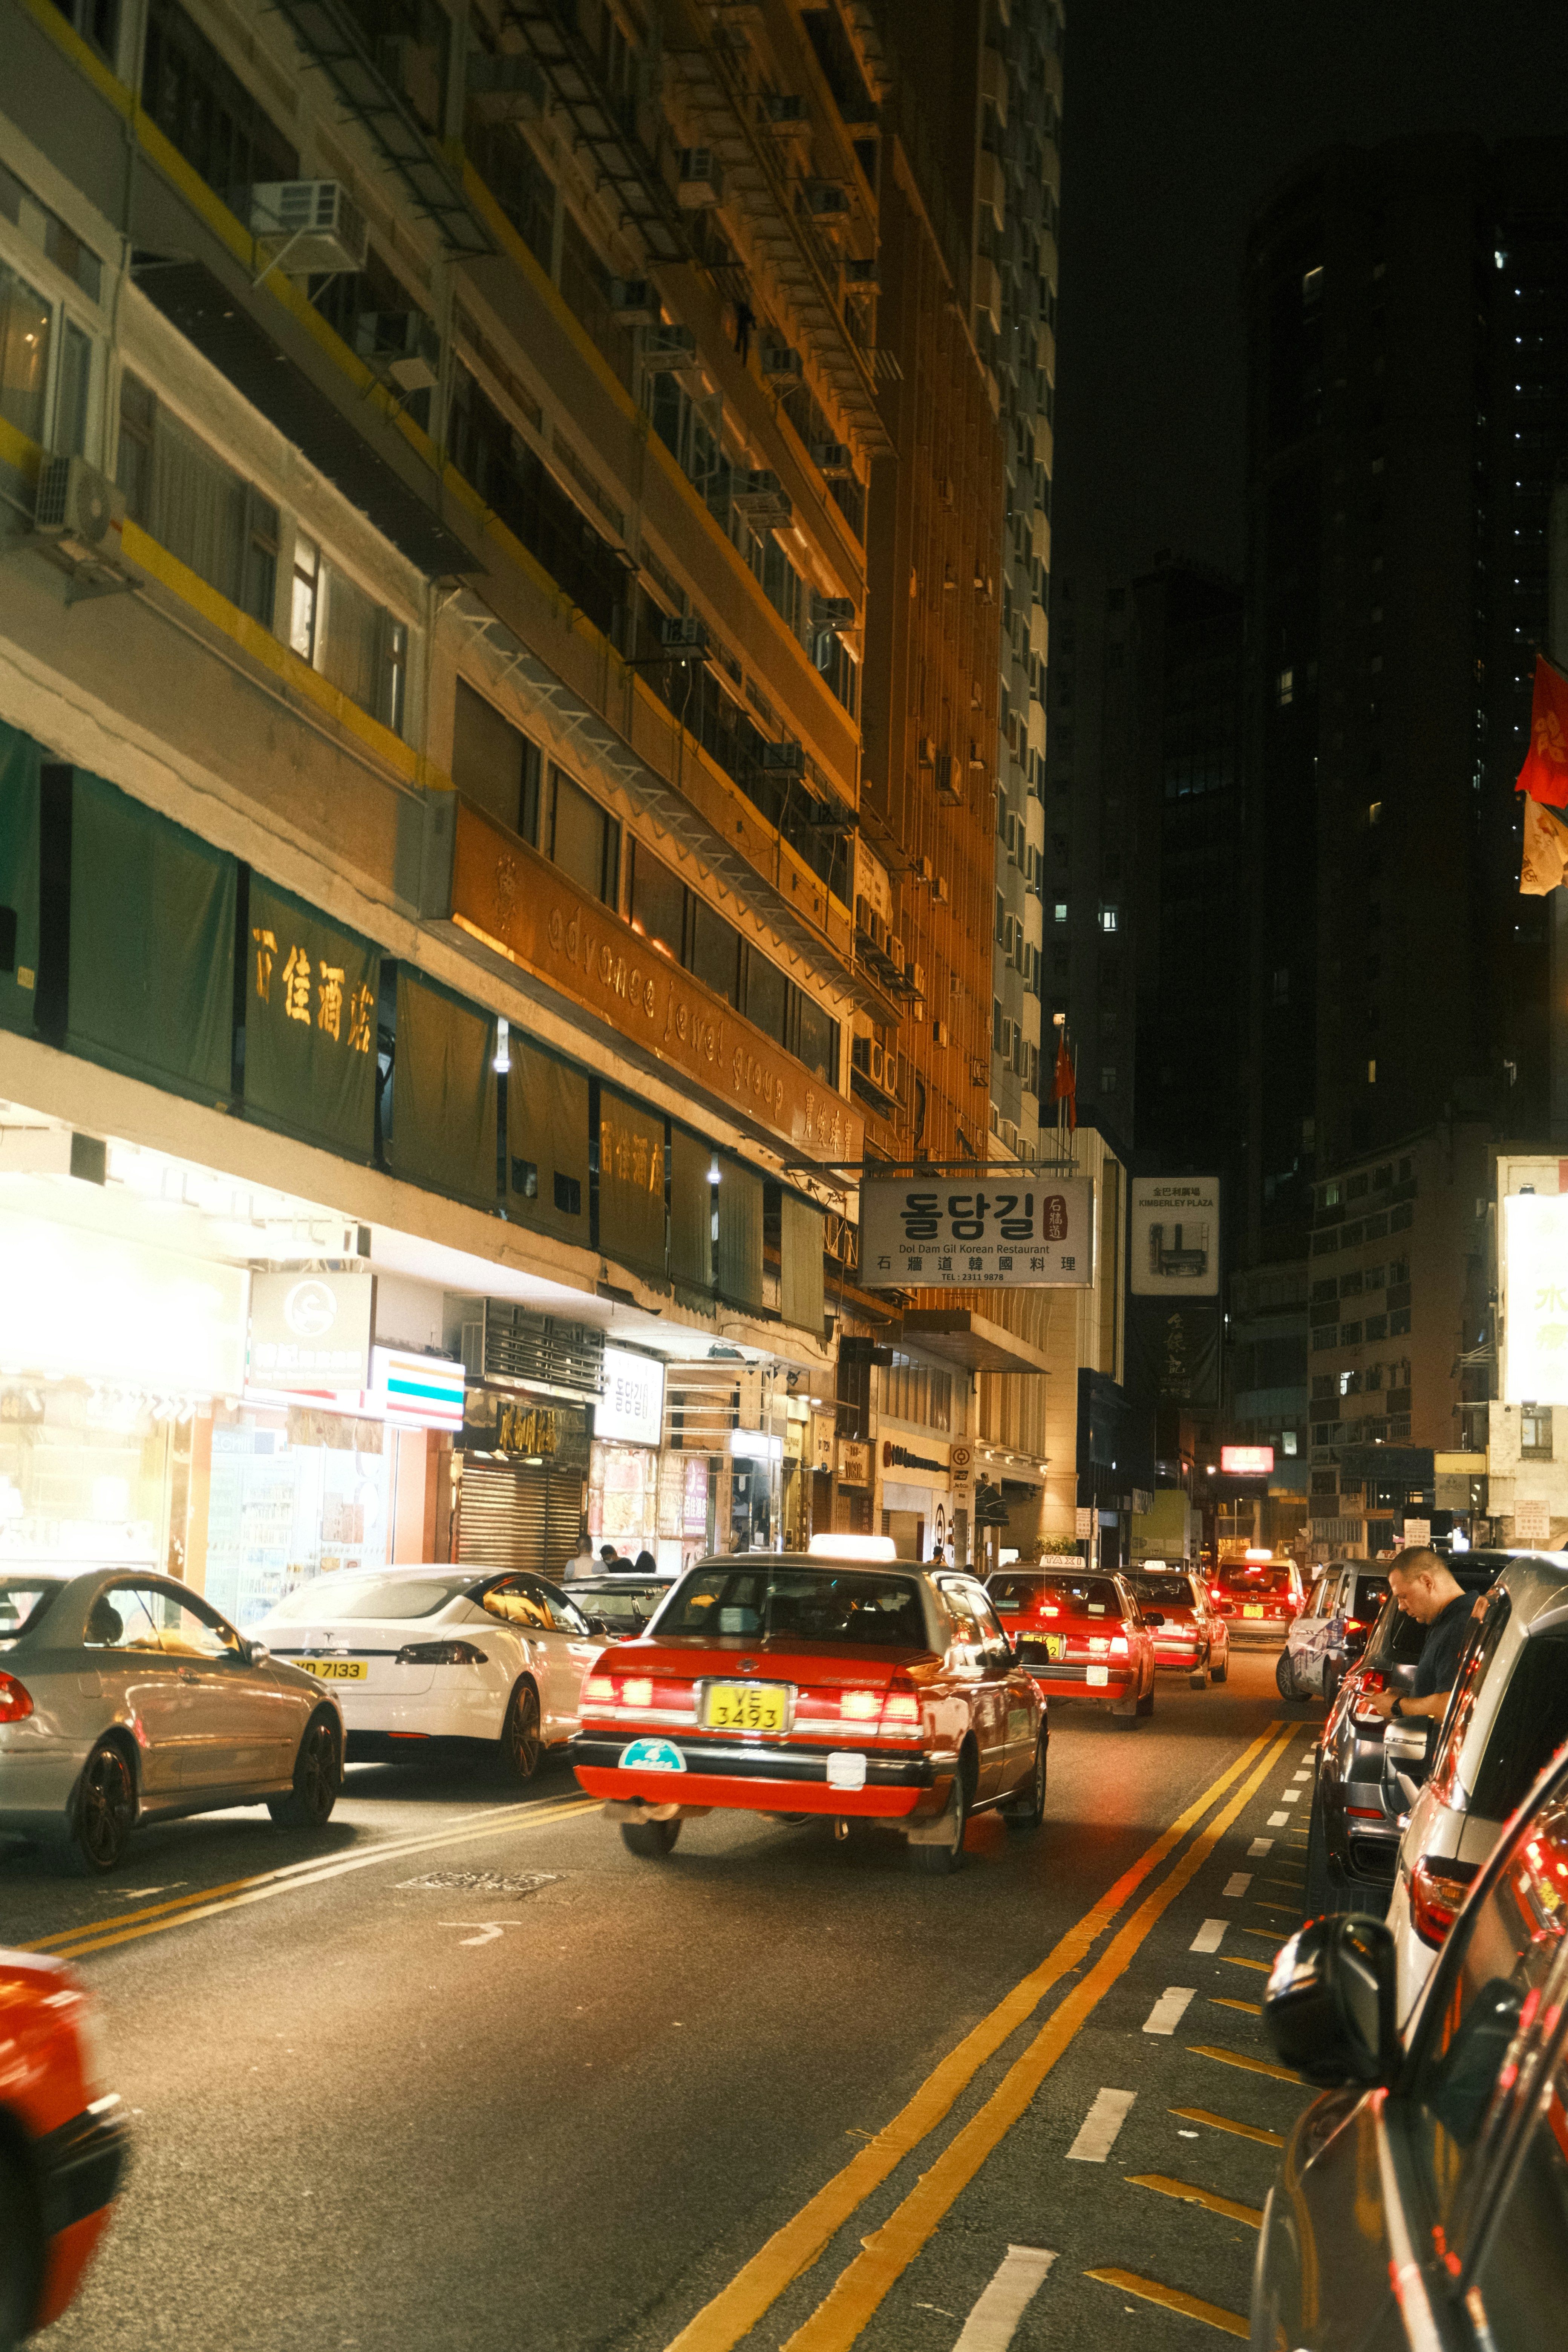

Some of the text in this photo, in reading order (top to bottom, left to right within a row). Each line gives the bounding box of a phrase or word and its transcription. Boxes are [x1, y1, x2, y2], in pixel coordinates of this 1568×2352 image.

[548, 906, 783, 1119] advance jewel group
[900, 1193, 1034, 1240] 돌담길
[899, 1244, 1050, 1254] Dol Dam Gil Korean Restaurant
[616, 1377, 642, 1416] 돌담길
[684, 1496, 707, 1518] 百佳酒店
[1044, 1556, 1082, 1565] TAXI
[323, 1663, 360, 1677] 7133
[733, 1689, 761, 1708] VE
[715, 1707, 776, 1728] 3493
